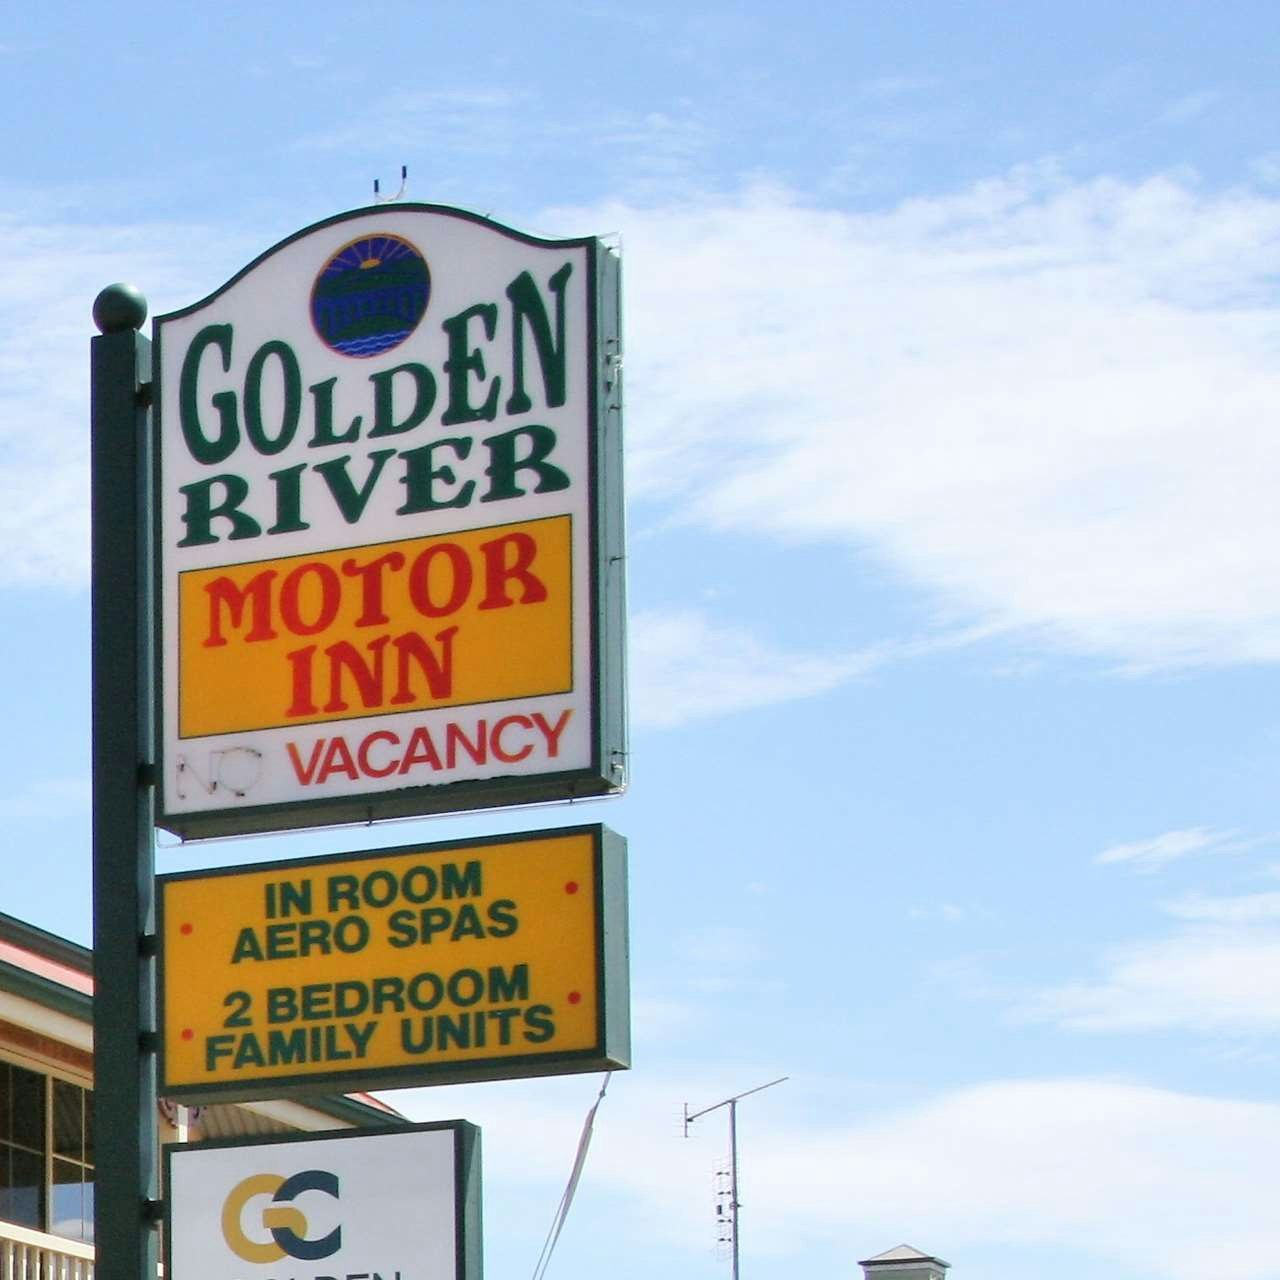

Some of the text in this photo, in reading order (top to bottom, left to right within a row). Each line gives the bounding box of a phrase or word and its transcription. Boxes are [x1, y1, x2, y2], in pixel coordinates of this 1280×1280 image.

[179, 262, 574, 465] GOLDEN
[176, 424, 571, 548] RIVER
[202, 532, 548, 648] MOTOR
[285, 626, 459, 719] INN
[285, 709, 576, 787] VACANCY
[264, 860, 482, 919] IN ROOM
[231, 899, 519, 964] AERO SPAS
[222, 964, 529, 1028] 2 BEDROOM
[205, 1004, 555, 1072] FAMILY UNITS
